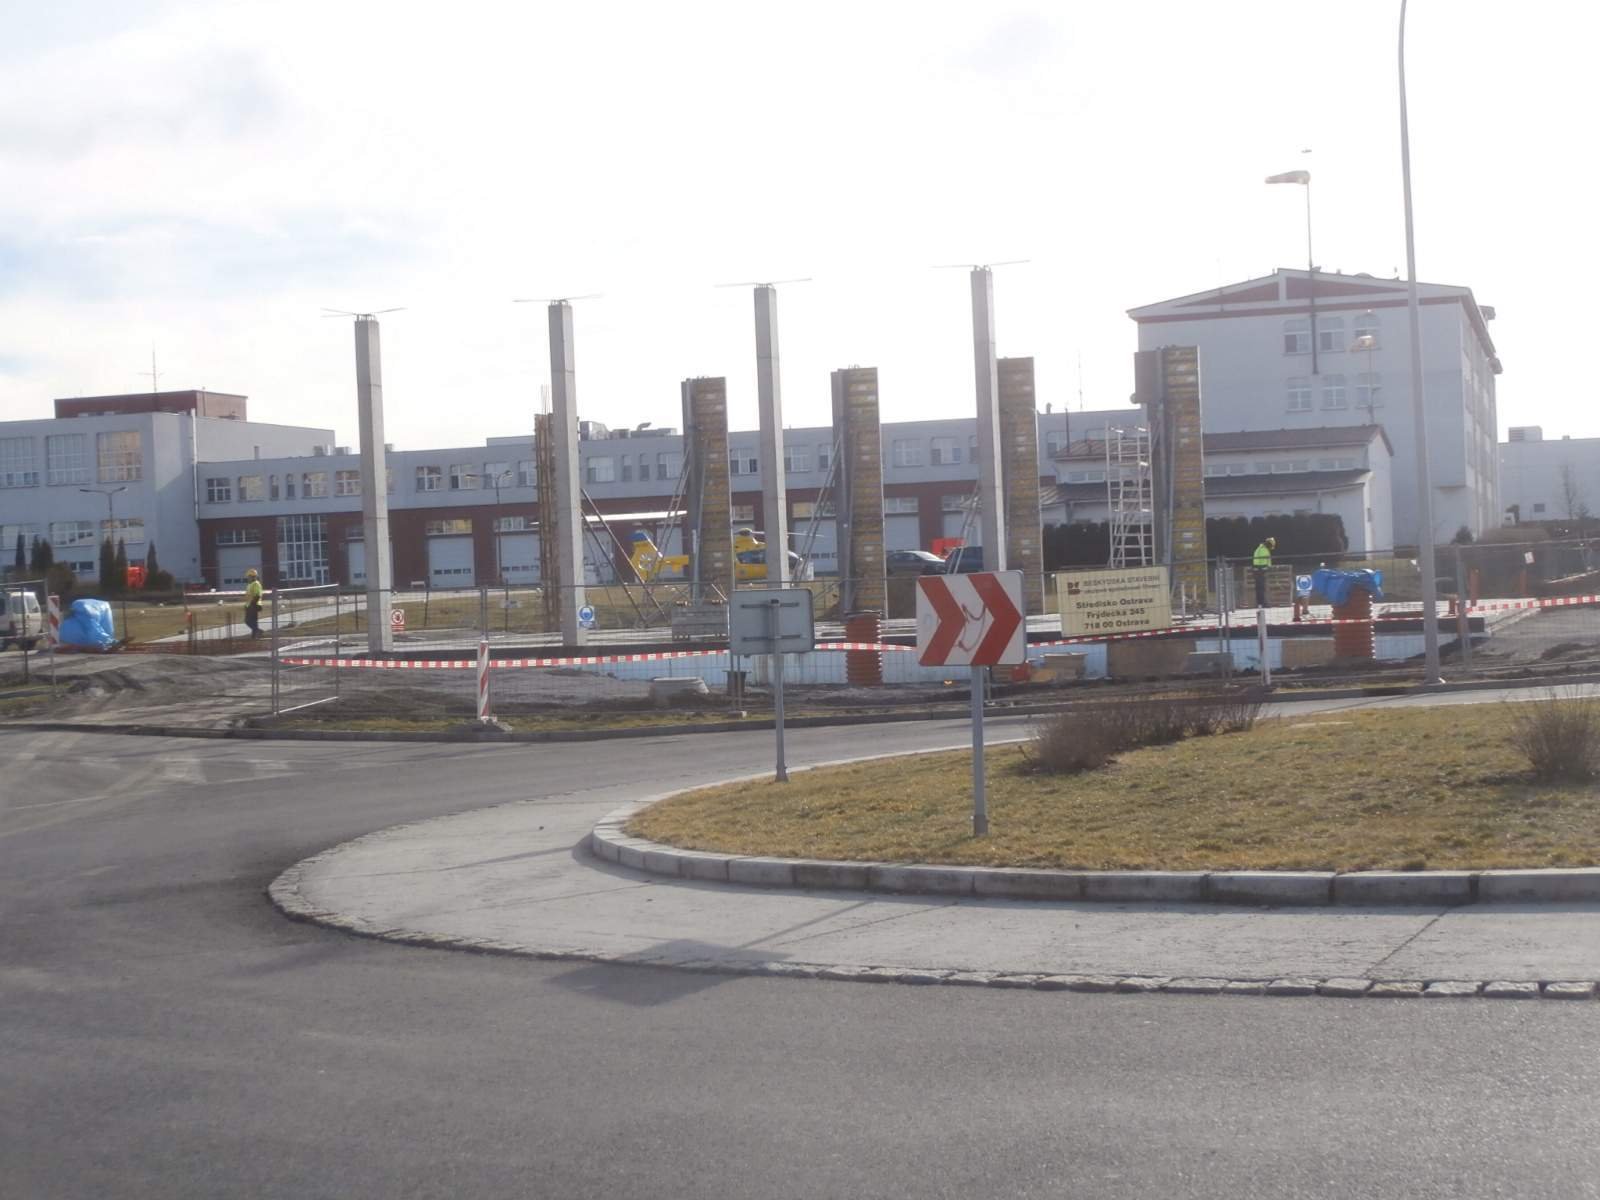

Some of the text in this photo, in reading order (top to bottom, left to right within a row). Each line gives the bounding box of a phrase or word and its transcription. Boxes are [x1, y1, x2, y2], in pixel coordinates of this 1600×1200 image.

[1119, 597, 1154, 606] Ostrava
[1102, 621, 1114, 629] 00
[1116, 618, 1149, 628] Ostrava
